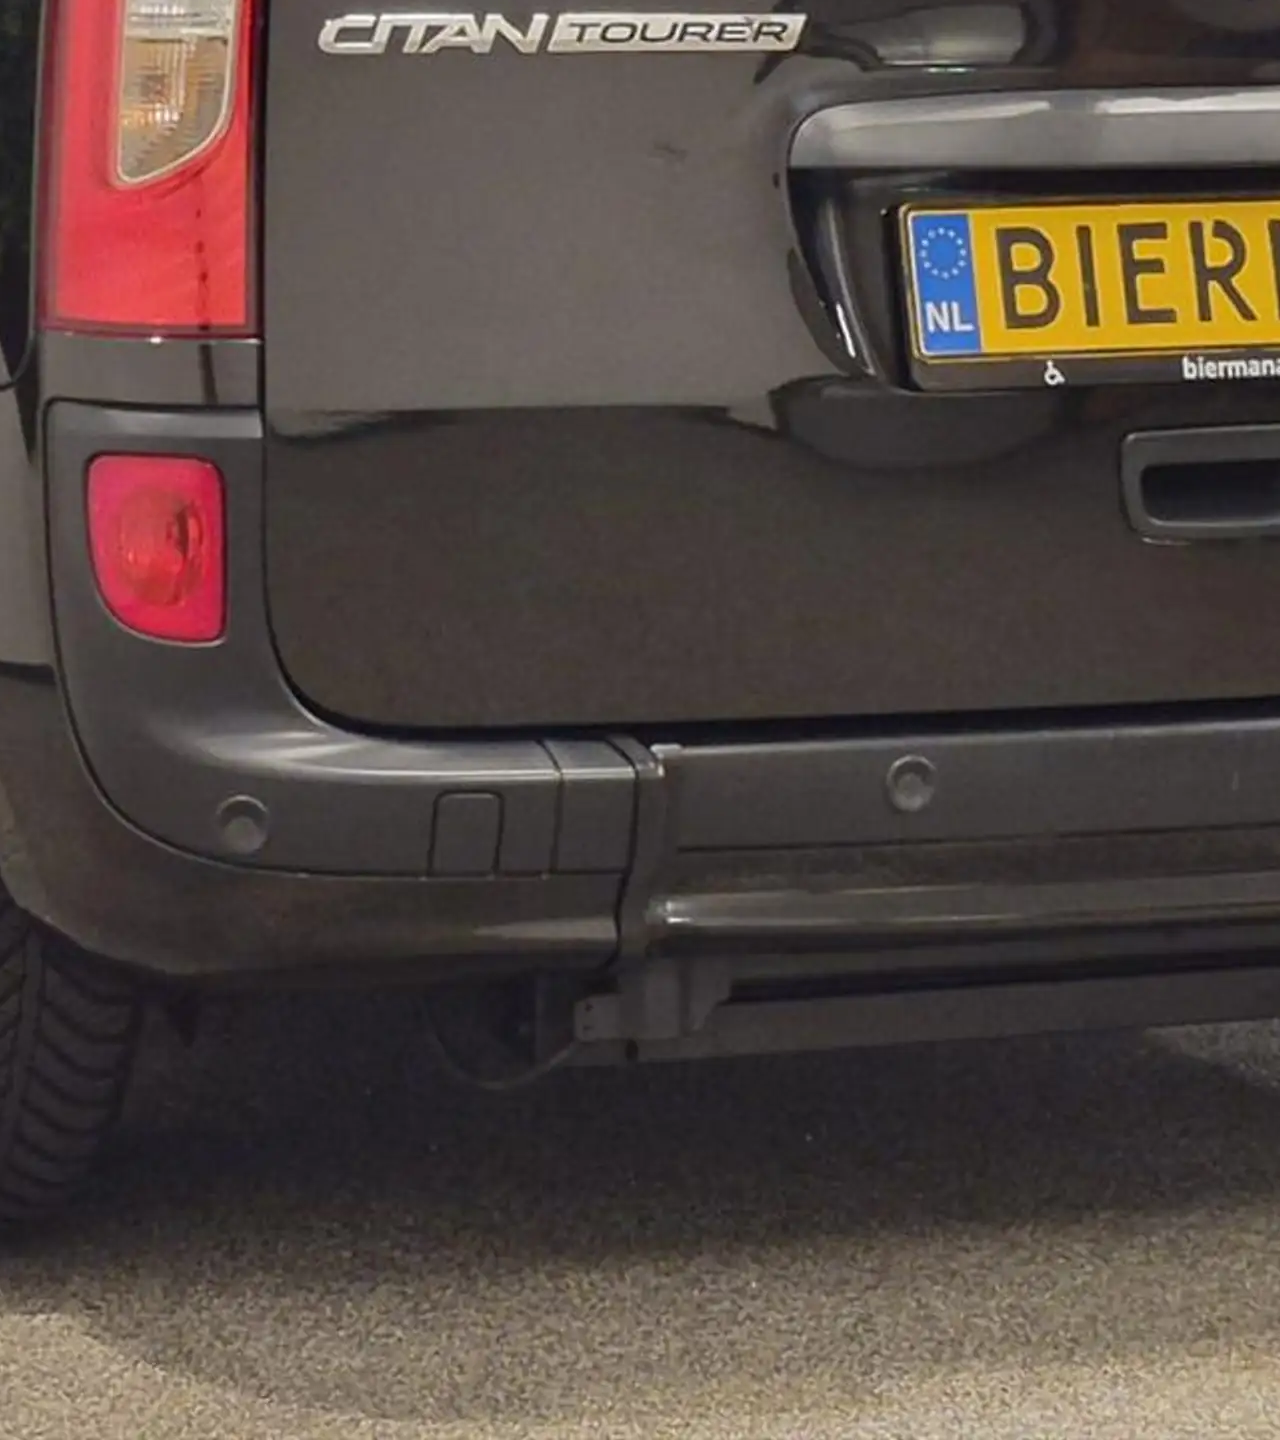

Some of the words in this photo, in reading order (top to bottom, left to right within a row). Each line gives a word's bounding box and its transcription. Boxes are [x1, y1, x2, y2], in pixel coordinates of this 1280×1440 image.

[318, 13, 550, 54] CITAN
[564, 18, 792, 46] TOURER
[925, 299, 975, 334] NL
